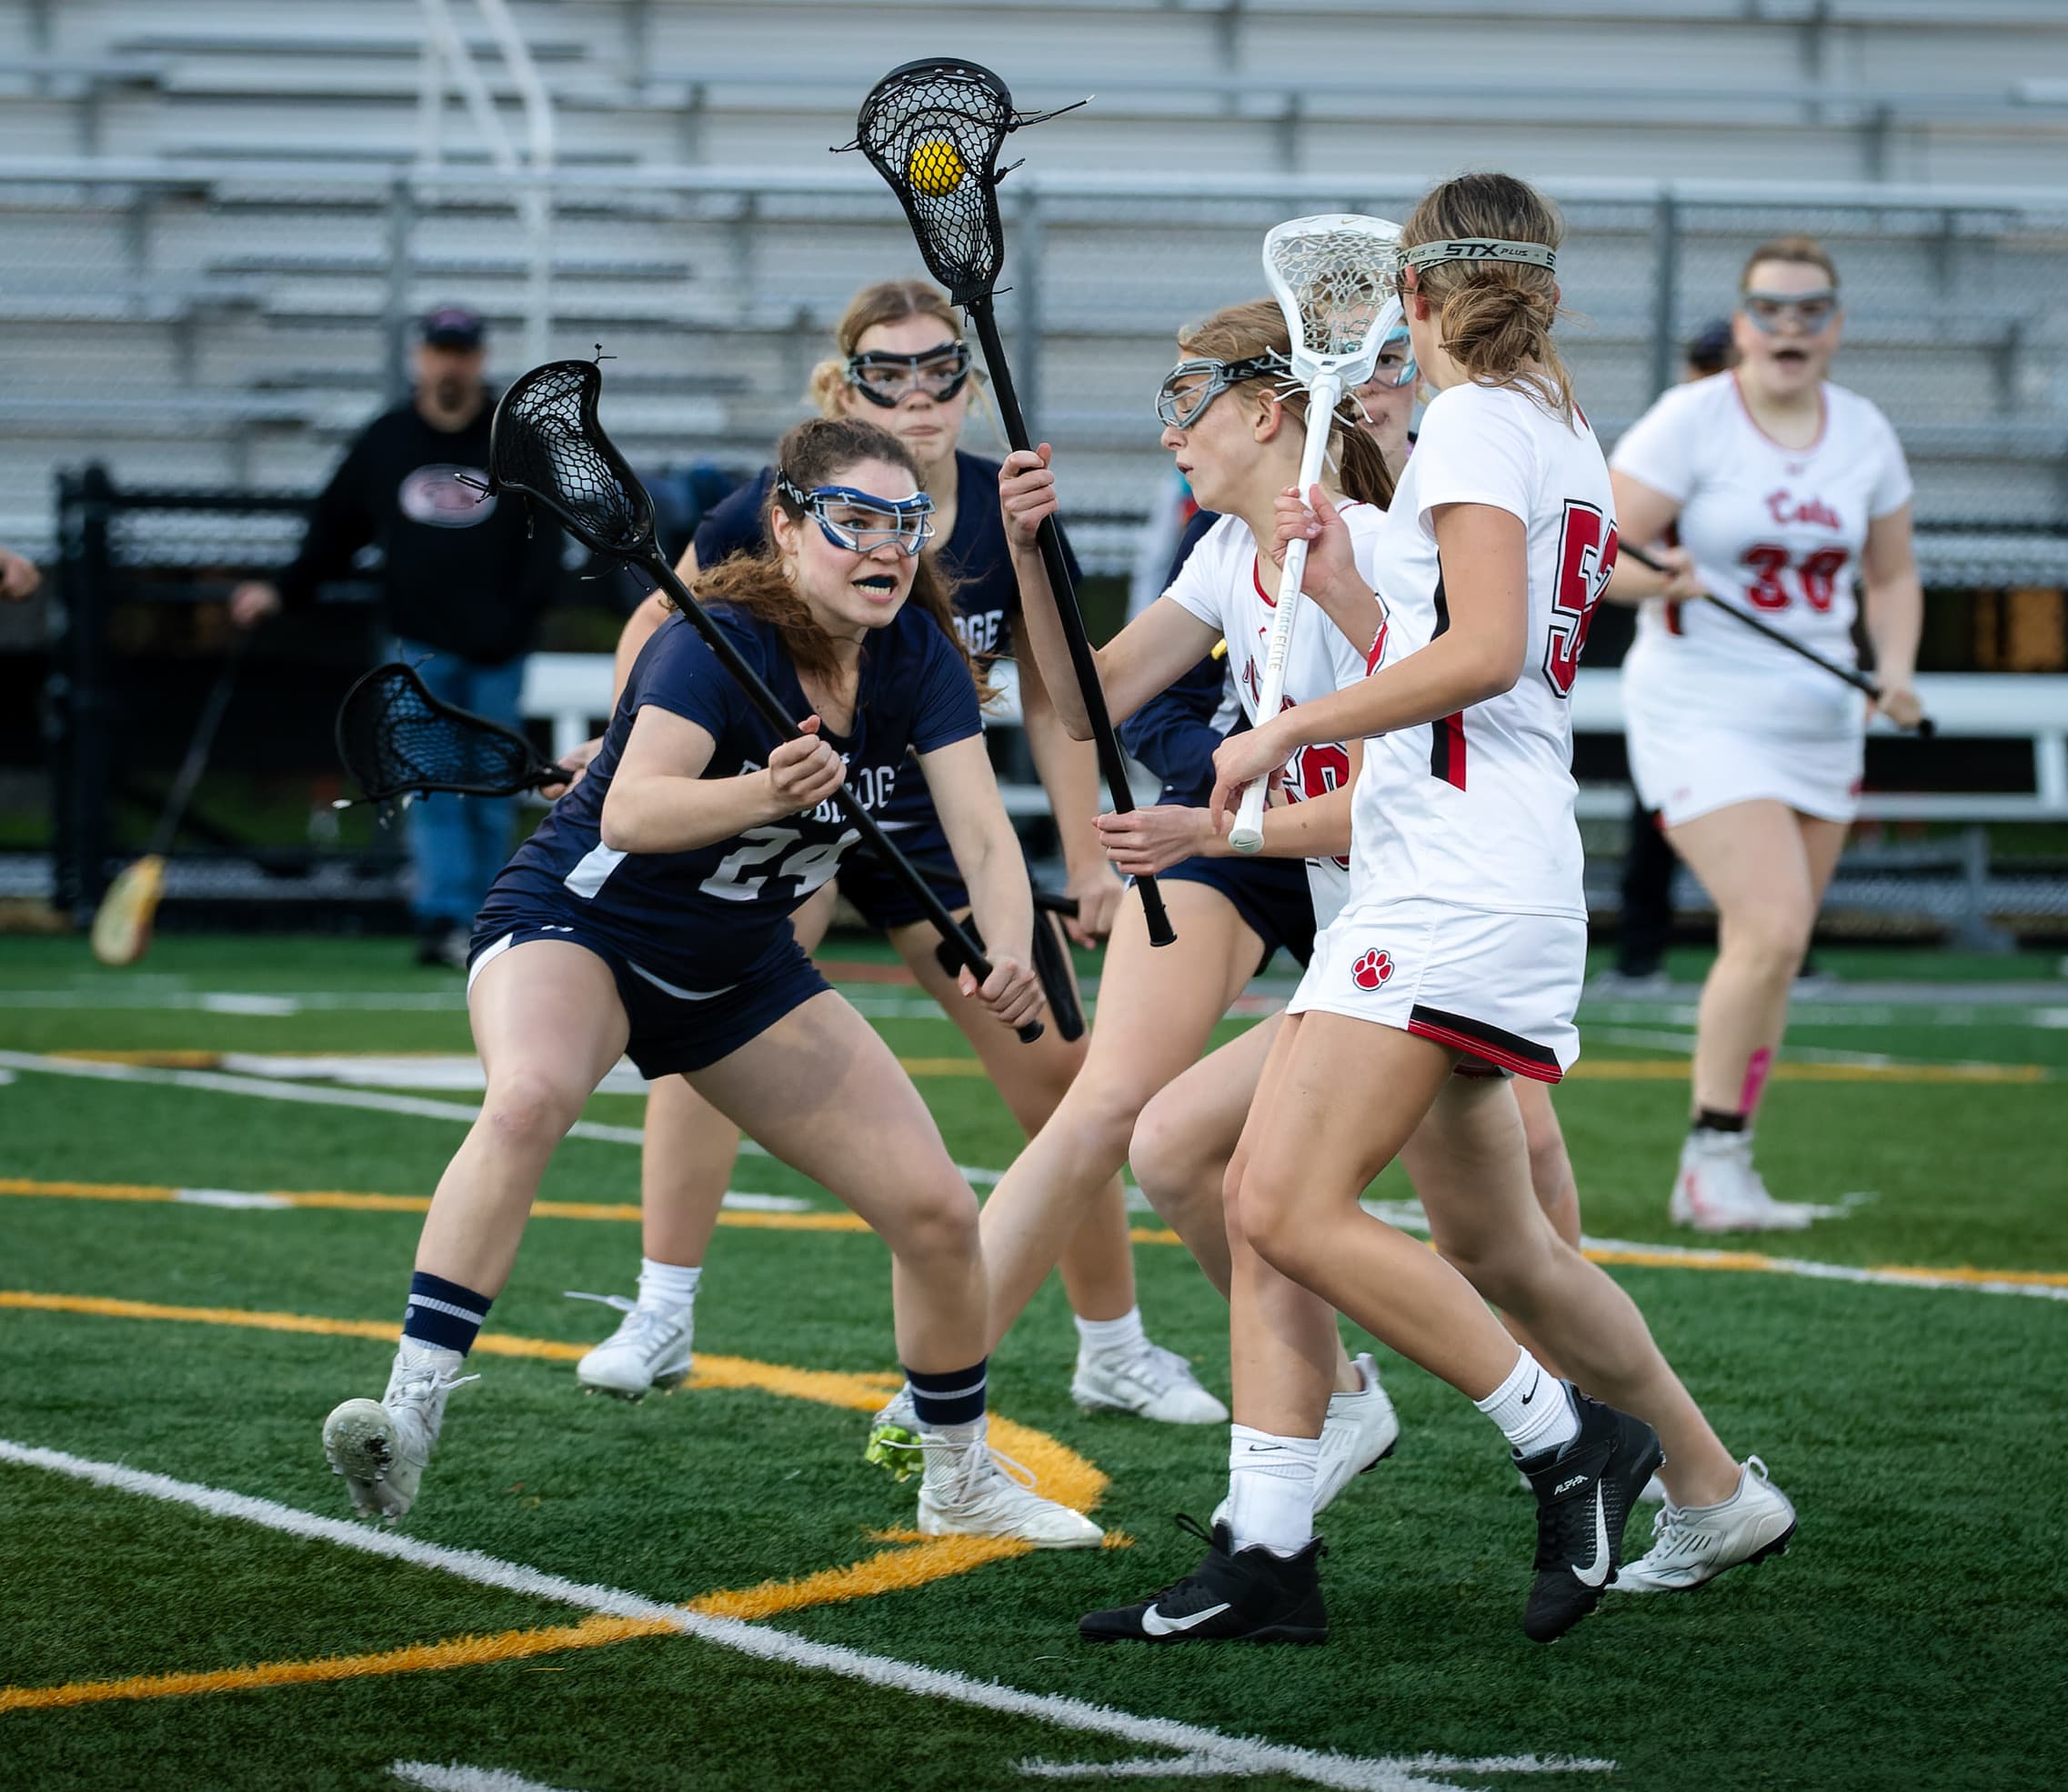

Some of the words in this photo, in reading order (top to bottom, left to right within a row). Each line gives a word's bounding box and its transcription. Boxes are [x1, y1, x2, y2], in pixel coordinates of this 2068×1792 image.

[1444, 243, 1500, 257] STX
[1741, 544, 1849, 614] 30
[1270, 636, 1288, 672] ELITE
[698, 825, 862, 901] 24
[1554, 1475, 1589, 1496] ALPHA
